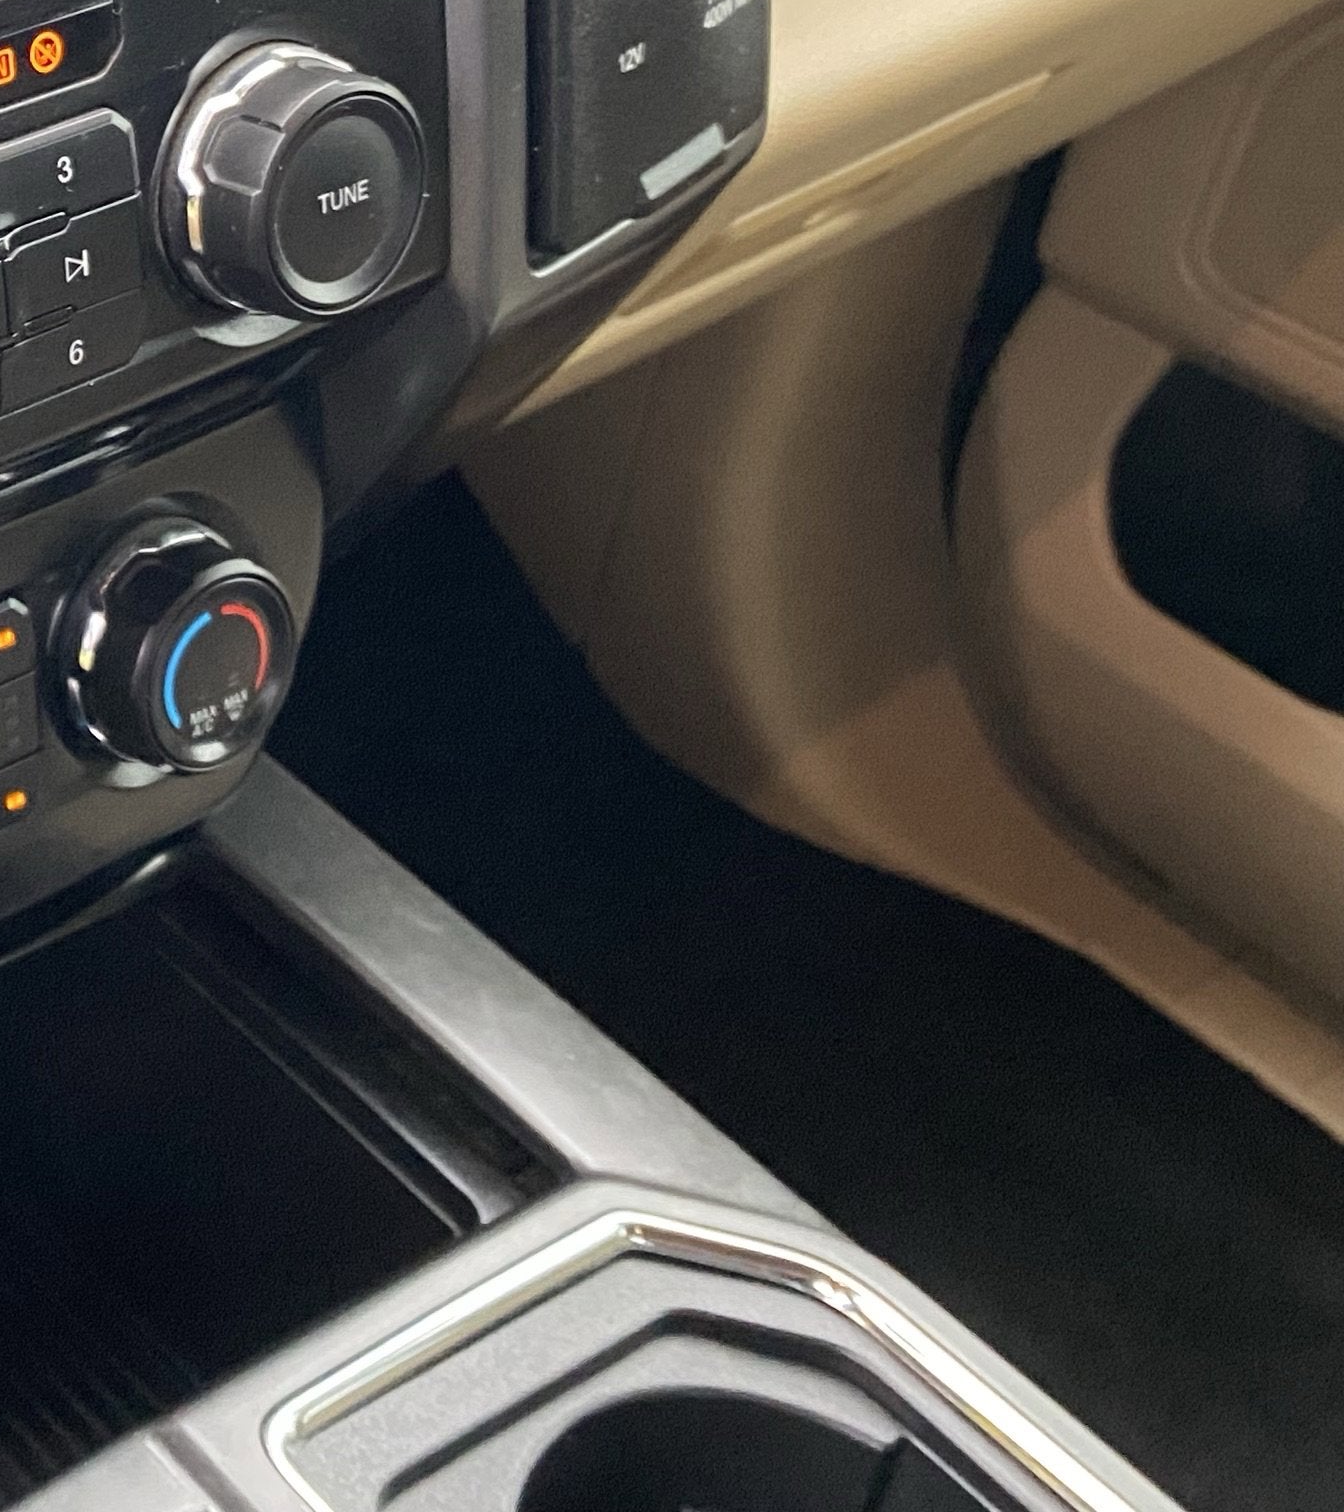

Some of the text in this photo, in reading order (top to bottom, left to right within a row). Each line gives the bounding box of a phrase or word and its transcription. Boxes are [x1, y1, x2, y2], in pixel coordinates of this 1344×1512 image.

[618, 41, 646, 74] 12V
[57, 156, 74, 184] 3
[317, 180, 369, 216] TUNE
[69, 339, 84, 365] 6
